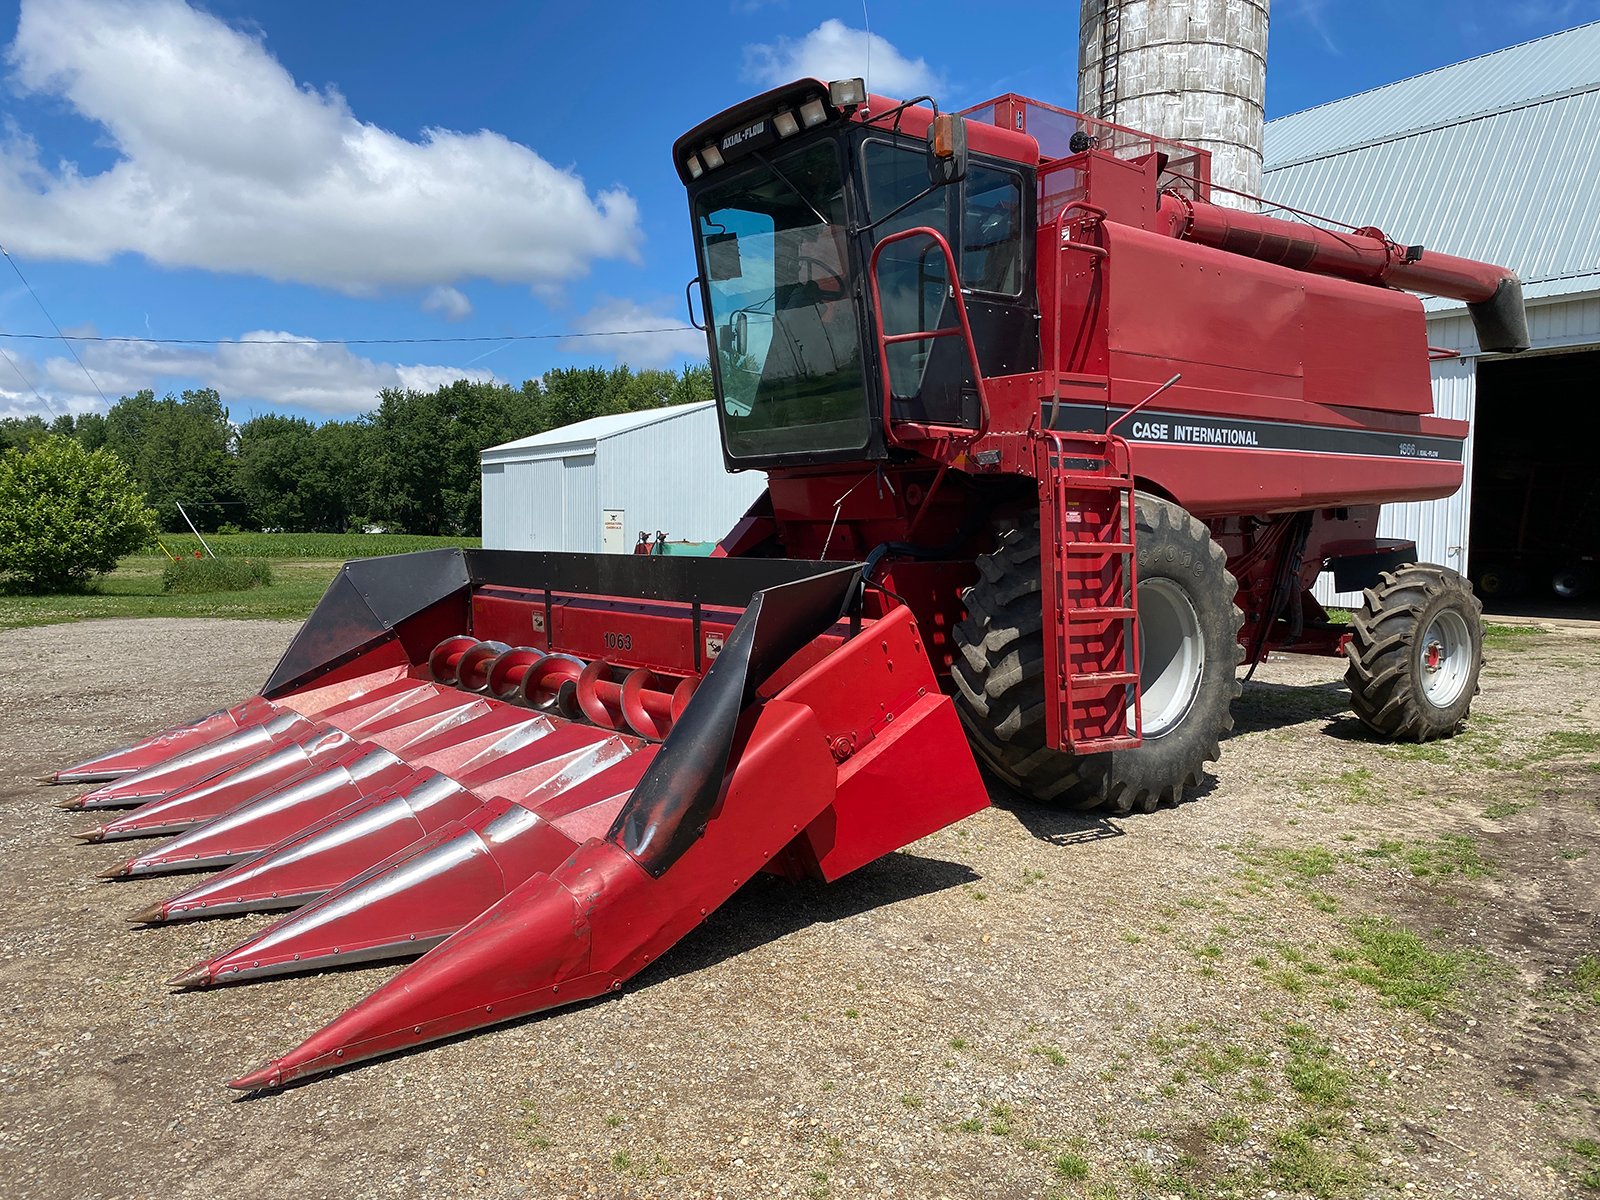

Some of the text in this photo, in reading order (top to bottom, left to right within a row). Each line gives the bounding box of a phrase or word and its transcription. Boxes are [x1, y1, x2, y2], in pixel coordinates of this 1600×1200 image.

[722, 121, 764, 150] AXIAL-FLOW
[1132, 421, 1259, 445] CASE INTERNATIONAL
[1399, 443, 1416, 455] 1666
[604, 632, 632, 651] 1063
